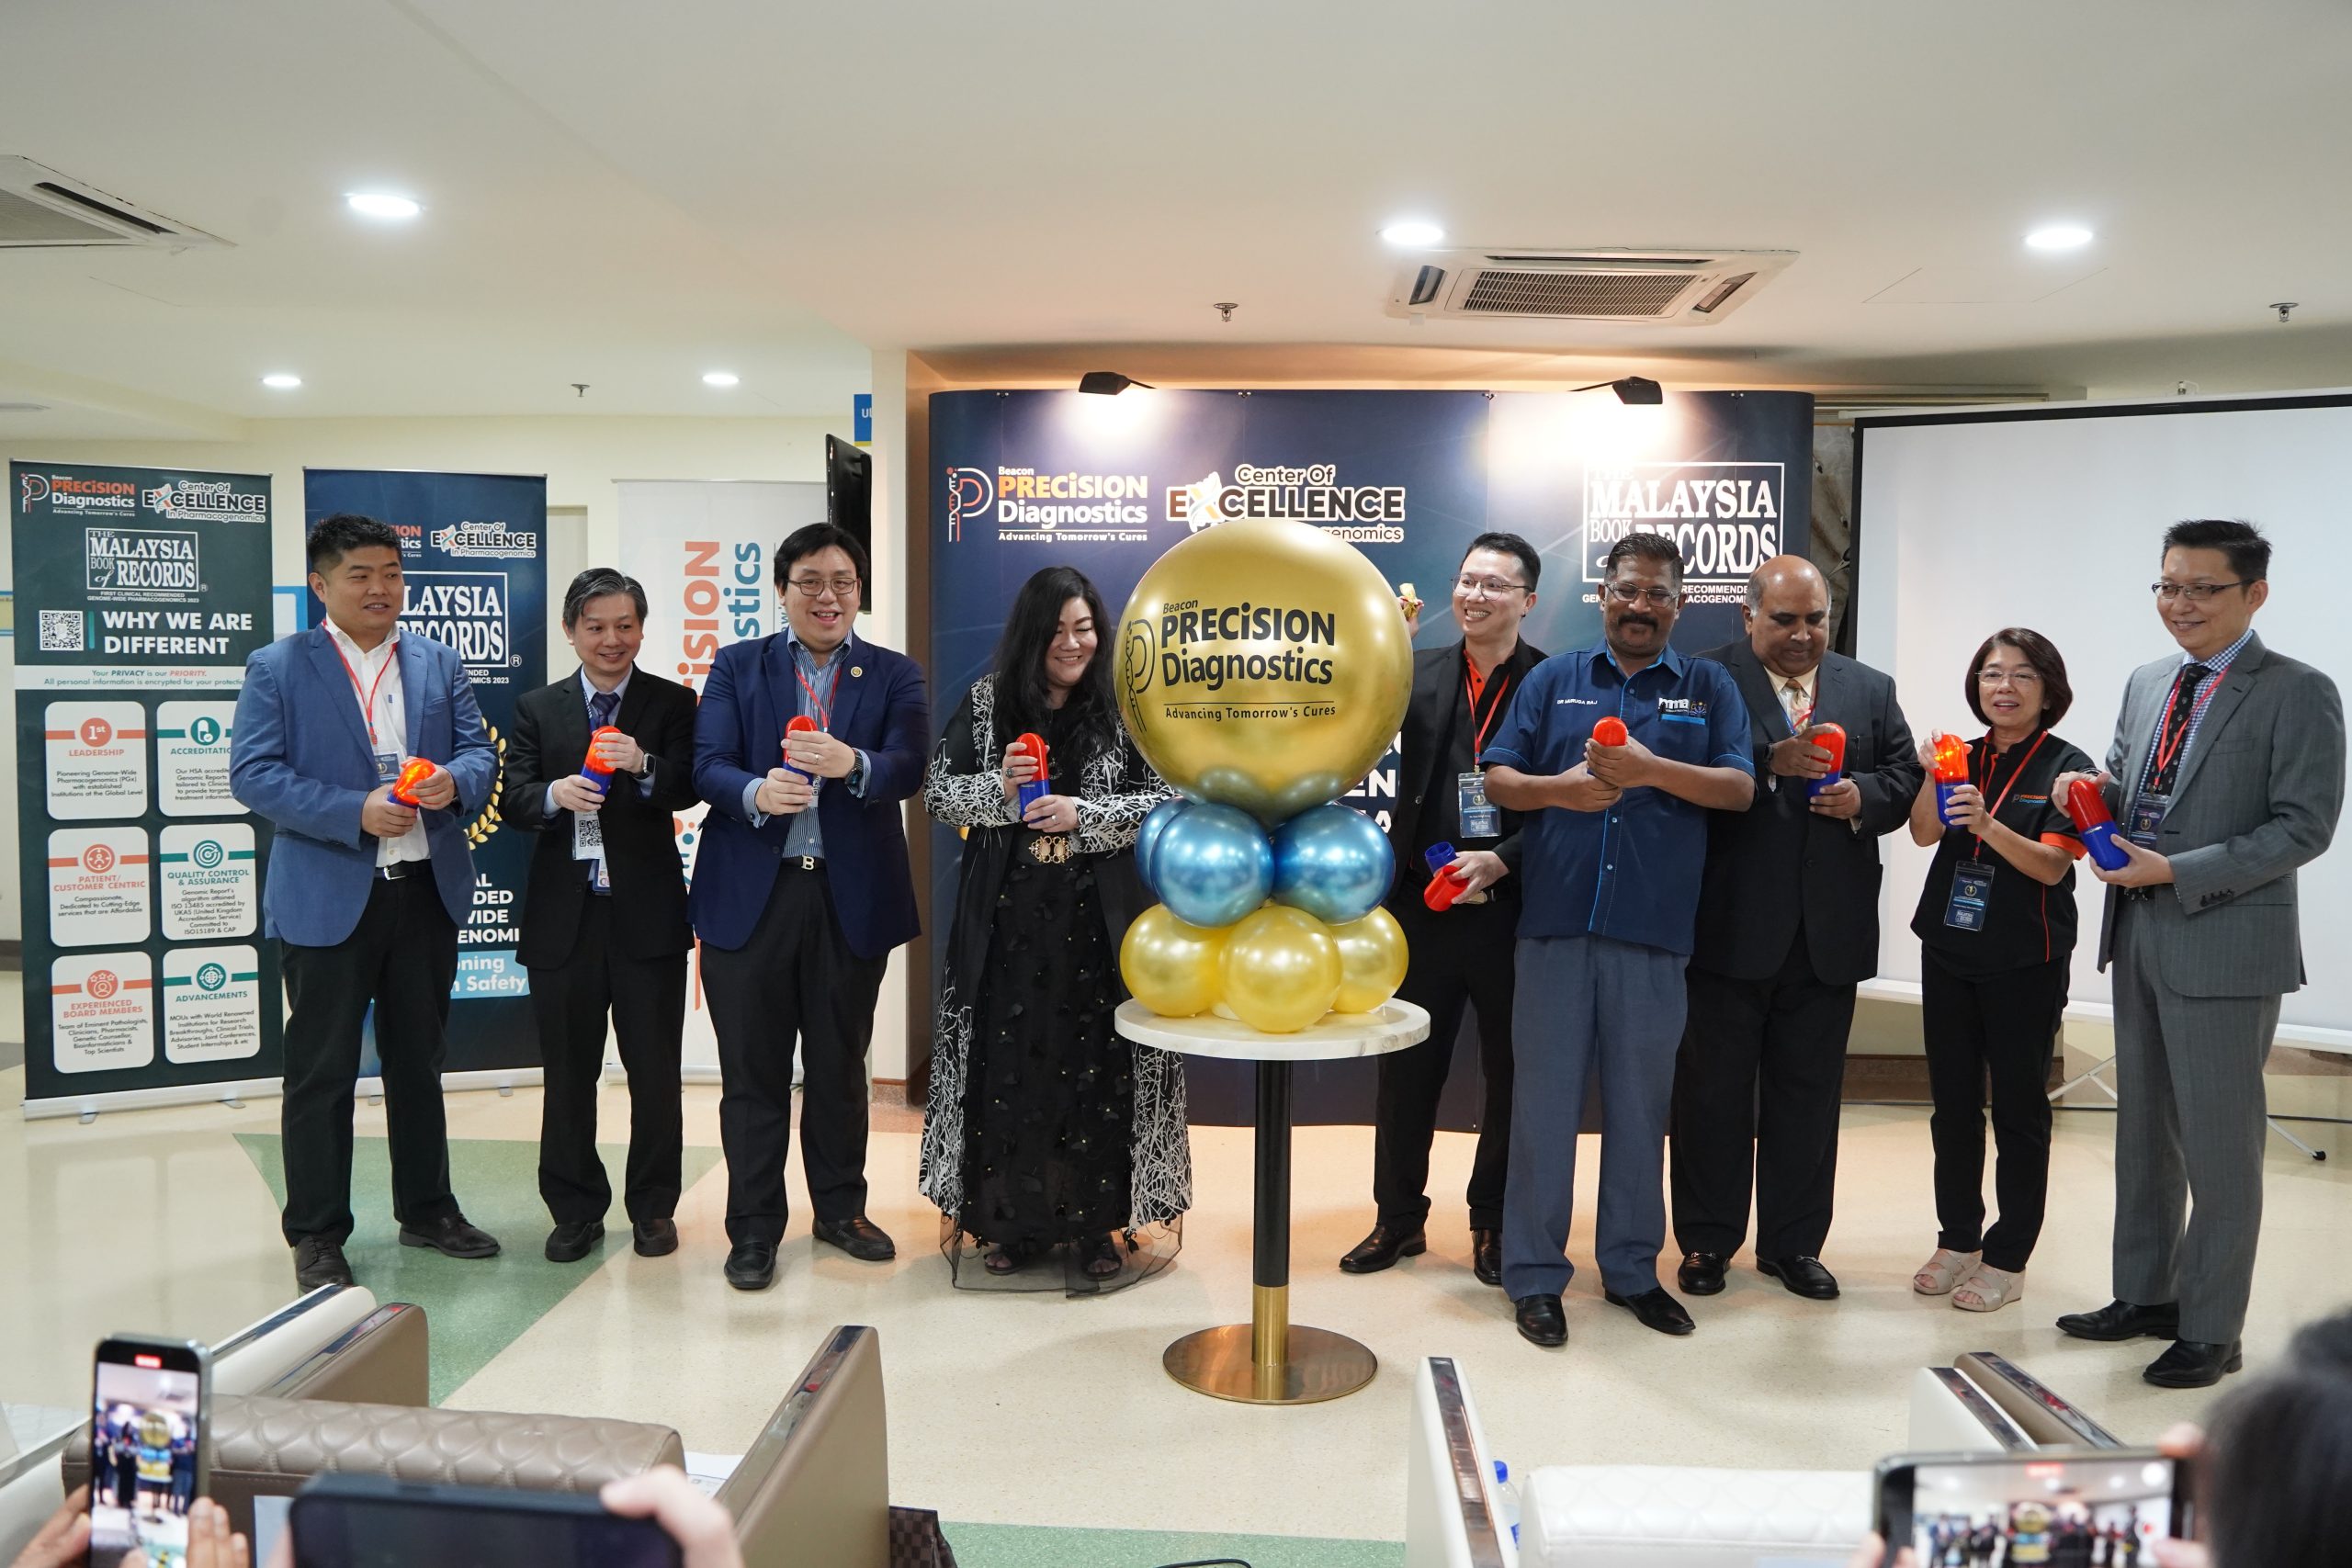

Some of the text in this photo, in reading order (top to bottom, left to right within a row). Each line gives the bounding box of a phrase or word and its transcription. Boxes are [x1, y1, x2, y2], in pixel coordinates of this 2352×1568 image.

[999, 467, 1034, 475] Beacon
[1238, 467, 1333, 483] Center Of
[179, 481, 230, 492] Center Of
[52, 492, 135, 508] Diagnostics
[143, 491, 265, 511] EXCELLENCE
[1170, 488, 1403, 519] EXCELLENCE
[1590, 479, 1777, 518] MALAYSIA
[178, 511, 265, 522] Pharmacogenomics
[999, 499, 1148, 529] Diagnostics
[999, 532, 1148, 542] Advancing Tomorrow's Cures
[1589, 519, 1633, 542] BOOK
[432, 532, 535, 547] EXCELLENCE
[90, 537, 194, 559] MALAYSIA
[461, 549, 535, 558] Pharmacogenomics
[1635, 524, 1776, 574] CORDS
[91, 558, 115, 569] BOOK
[95, 570, 114, 587] of
[117, 560, 195, 587] RECORDS
[1682, 585, 1748, 594] RECOMMENDE
[401, 586, 503, 616] LAYSIA
[1163, 600, 1198, 615] Beacon
[102, 611, 252, 630] WHY WE ARE
[104, 637, 229, 654] DIFFERENT
[1161, 646, 1333, 691] Diagnostics
[1166, 705, 1335, 721] Advancing Tomorrow's Cures
[88, 726, 106, 739] 1st
[107, 881, 146, 889] CENTRIC
[467, 975, 526, 994] Safety
[71, 999, 132, 1010] EXPERIENCED
[175, 991, 247, 1002] ADVANCEMENTS
[63, 1006, 142, 1018] BOARD MEMBERS
